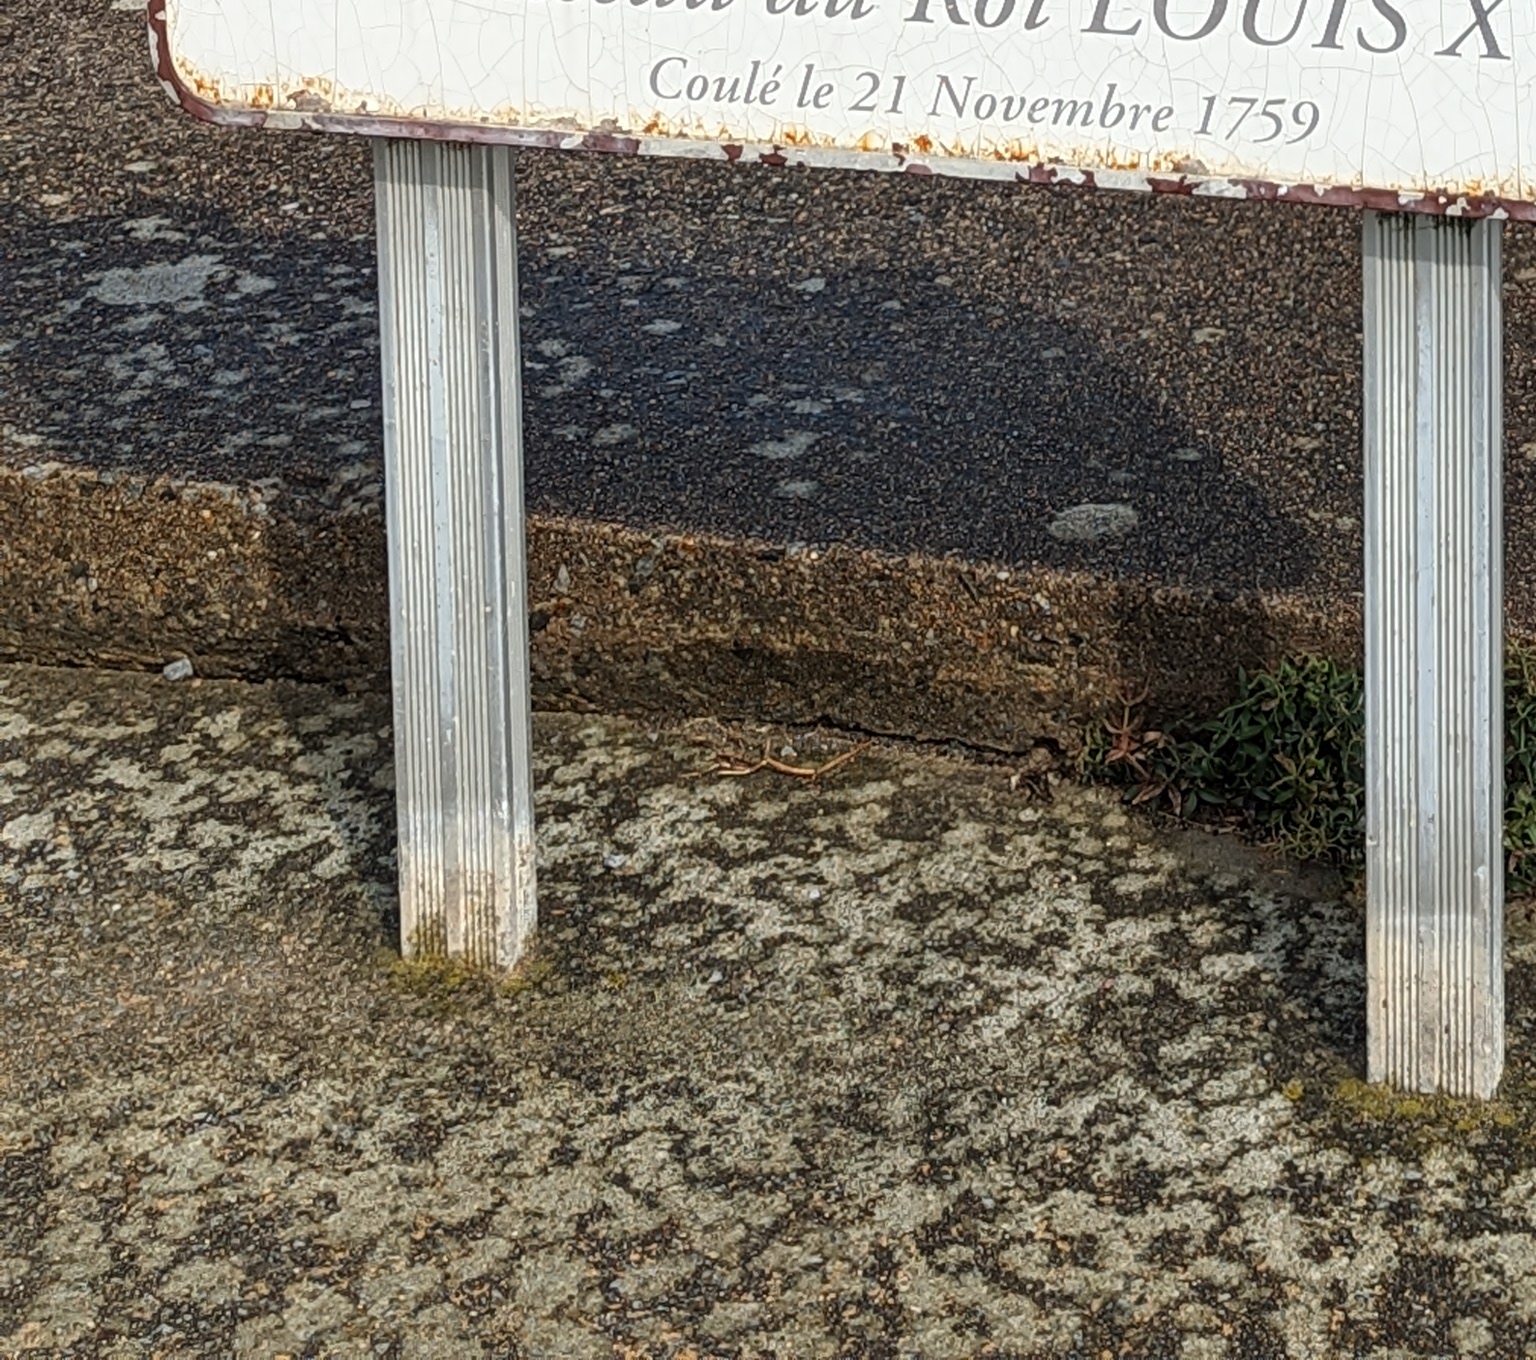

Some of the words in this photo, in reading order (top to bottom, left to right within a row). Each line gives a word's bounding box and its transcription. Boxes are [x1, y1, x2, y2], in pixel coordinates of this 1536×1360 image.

[649, 56, 783, 107] Coulé
[796, 63, 834, 110] le
[850, 72, 906, 114] 21
[928, 75, 1175, 133] Novembre
[1197, 95, 1320, 143] 1759
